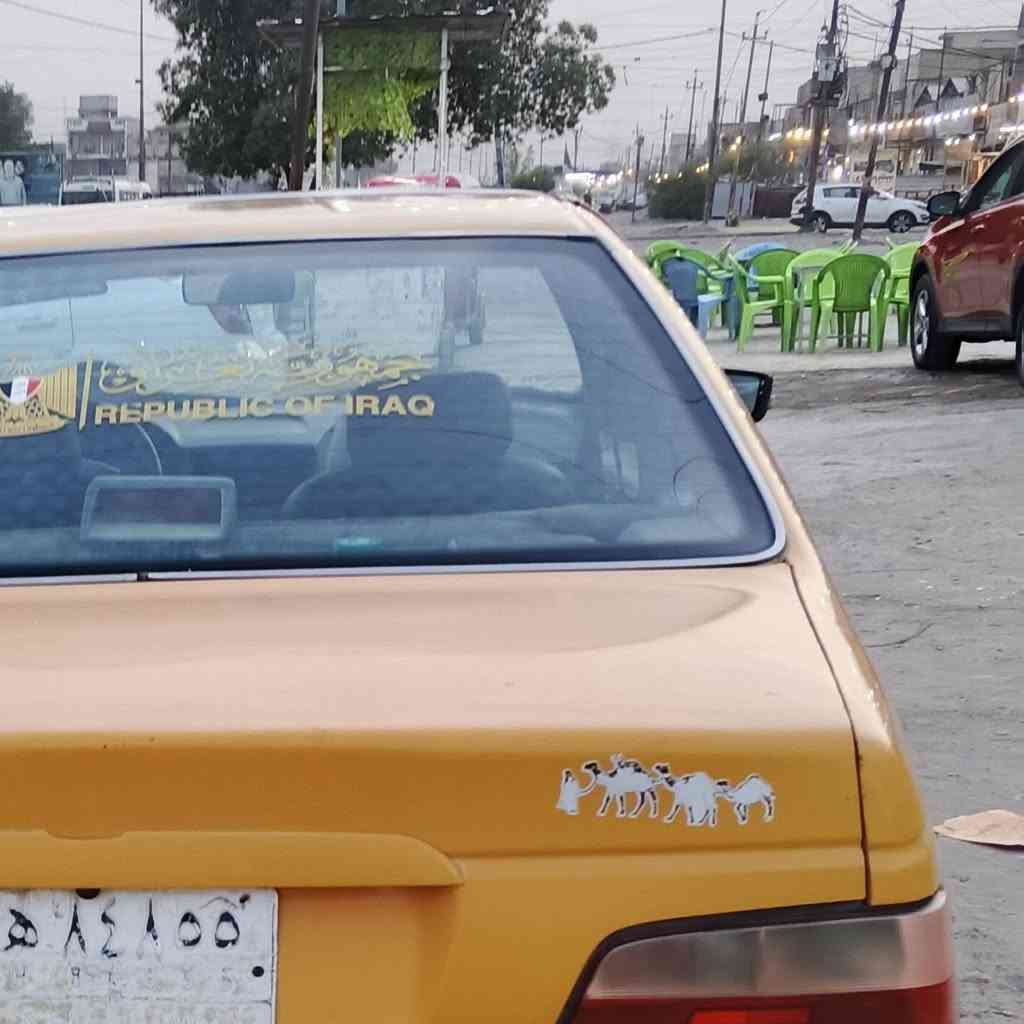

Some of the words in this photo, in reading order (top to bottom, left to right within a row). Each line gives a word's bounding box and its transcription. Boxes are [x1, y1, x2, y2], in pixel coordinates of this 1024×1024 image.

[94, 396, 274, 425] REPUBLIC
[284, 396, 336, 417] OF
[344, 393, 436, 417] IRAQ
